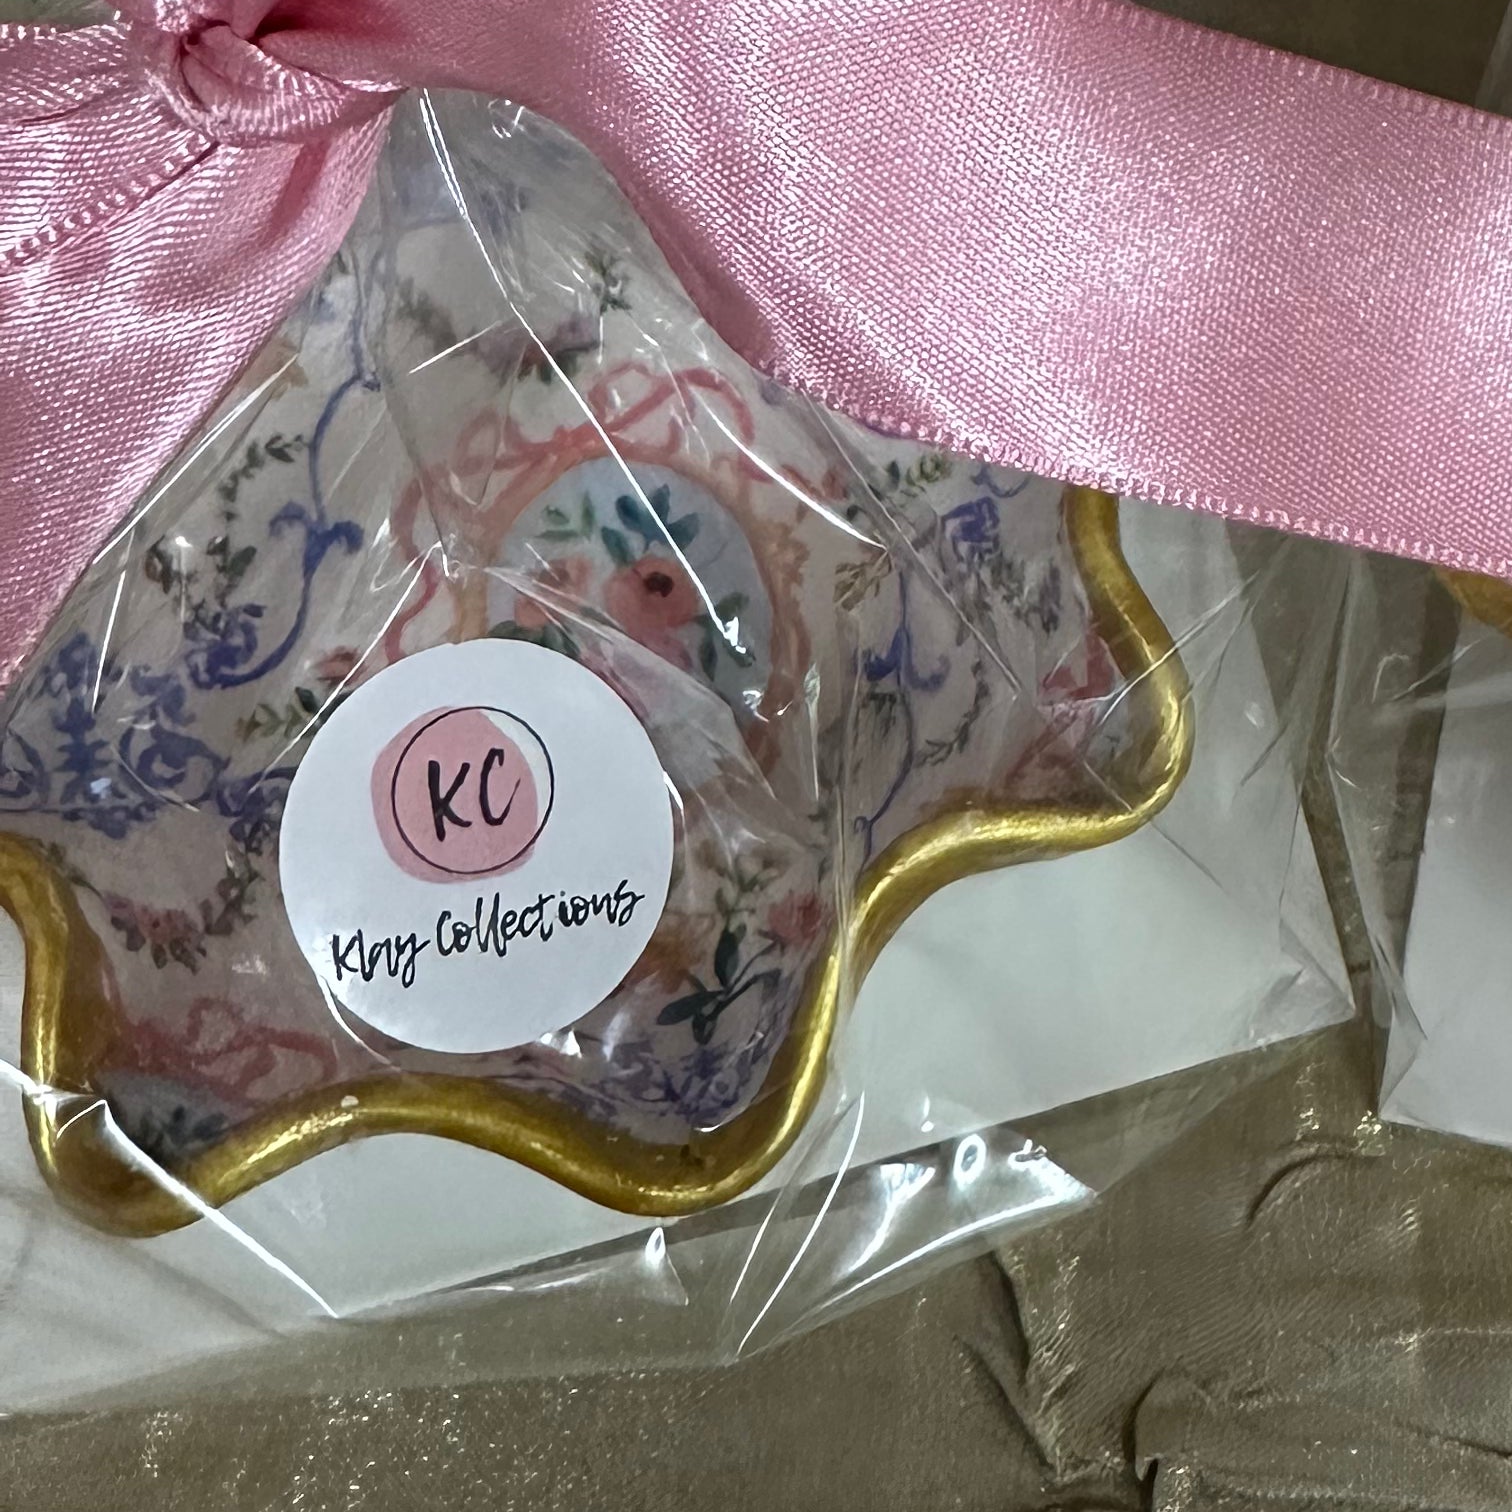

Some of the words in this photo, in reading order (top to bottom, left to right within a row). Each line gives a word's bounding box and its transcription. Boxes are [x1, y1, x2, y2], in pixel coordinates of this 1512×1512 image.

[427, 747, 521, 842] KC
[331, 928, 431, 988] Klay
[435, 879, 645, 958] Collections
